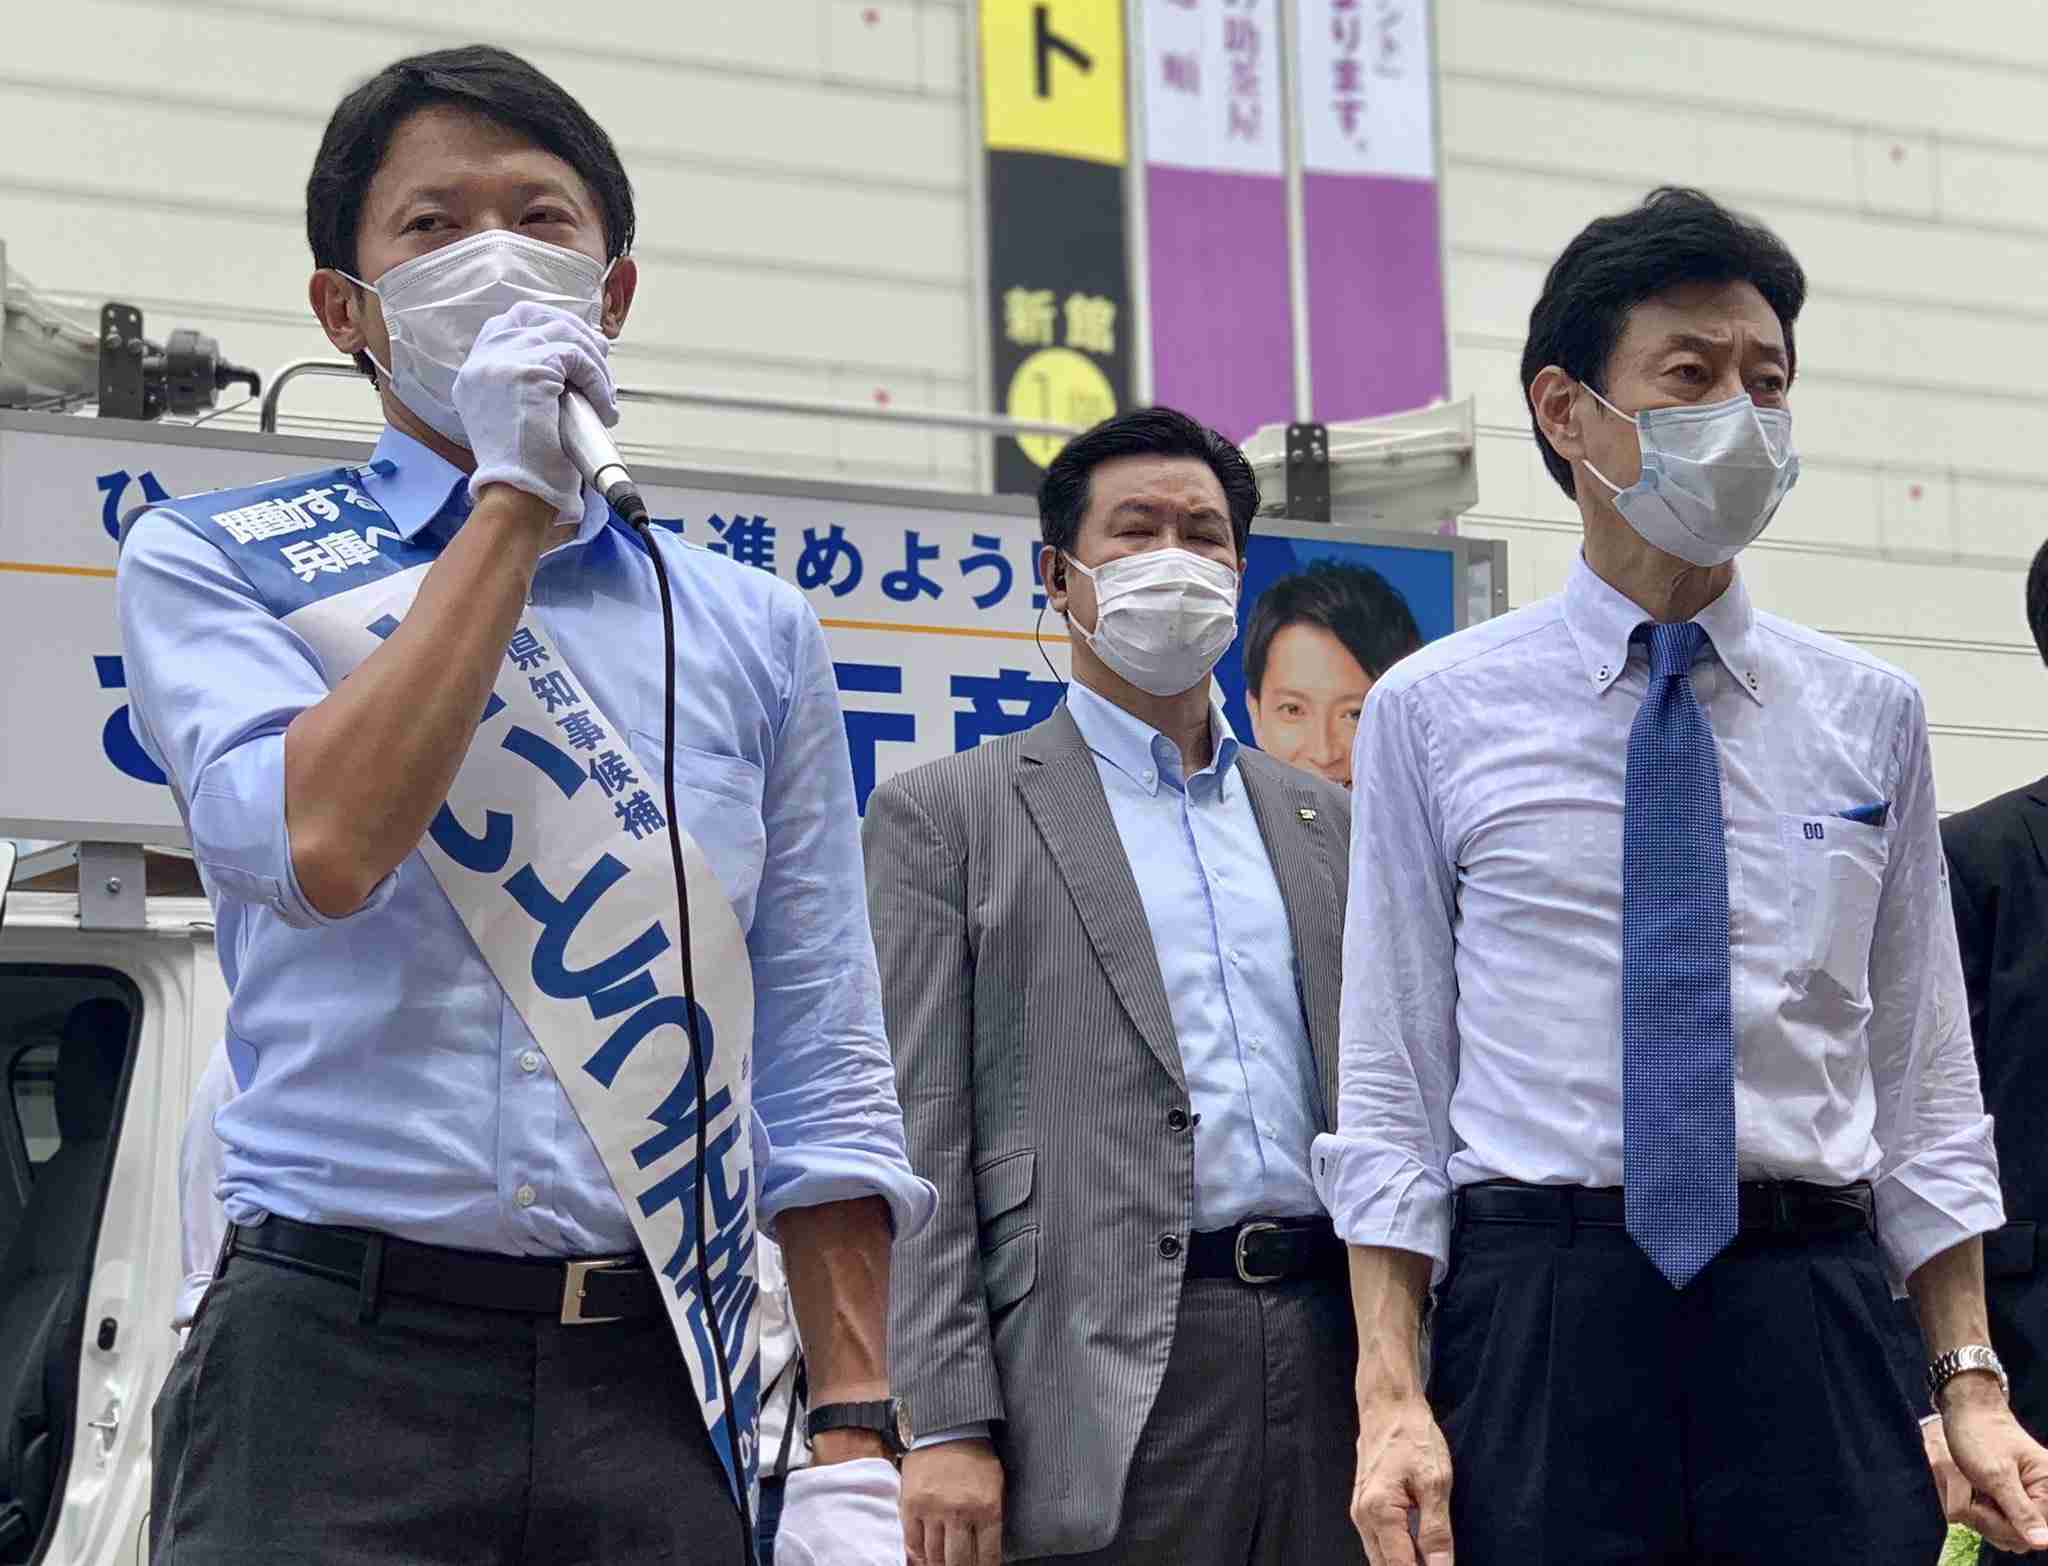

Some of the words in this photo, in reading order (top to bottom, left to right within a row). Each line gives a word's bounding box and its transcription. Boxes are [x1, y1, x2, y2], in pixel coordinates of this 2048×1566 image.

[1003, 285, 1117, 354] 新館
[280, 525, 415, 584] 兵庫へ
[508, 626, 667, 840] 県知事候補
[366, 613, 760, 1405] いとう元彦
